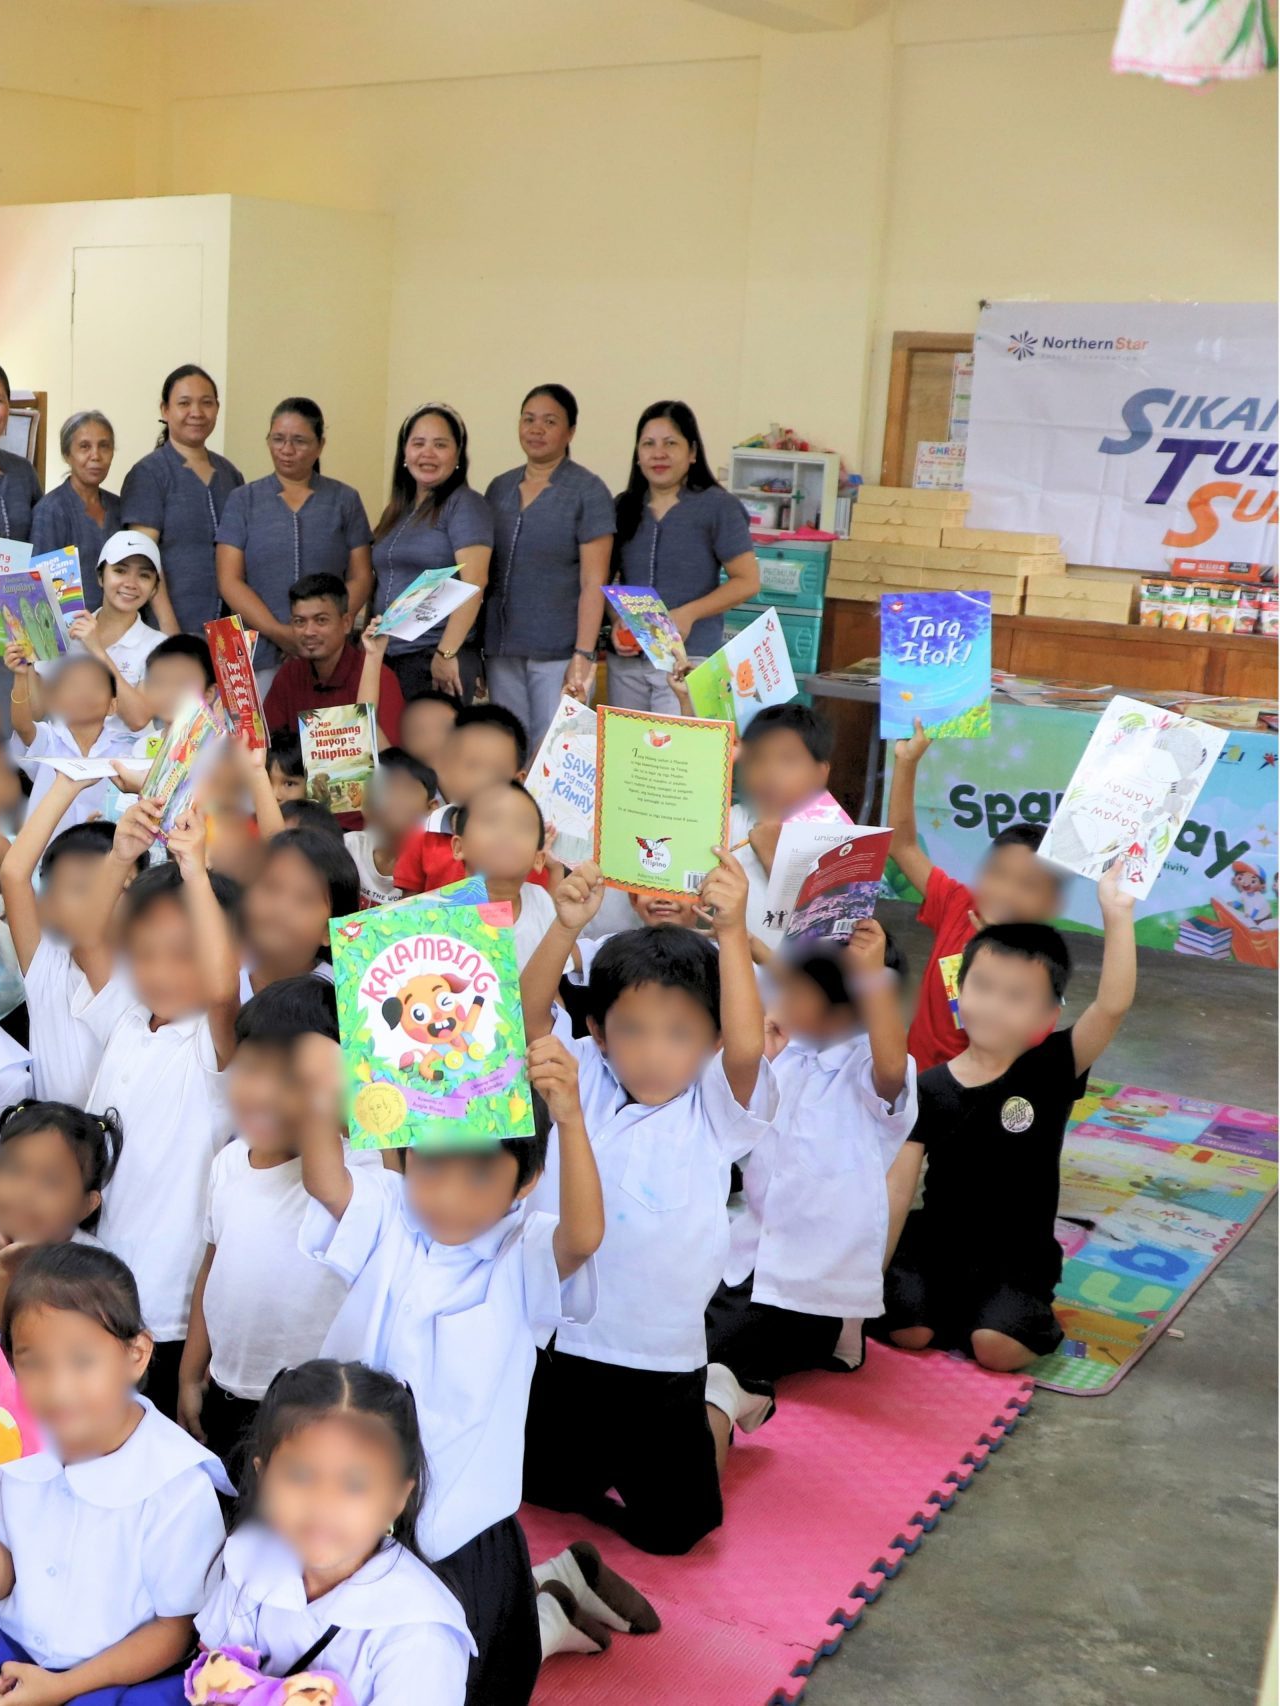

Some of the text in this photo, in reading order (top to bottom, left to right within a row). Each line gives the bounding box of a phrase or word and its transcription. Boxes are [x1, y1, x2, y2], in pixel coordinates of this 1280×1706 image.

[1162, 481, 1278, 548] SU
[906, 615, 966, 642] Tara,
[762, 636, 782, 686] Sampung
[898, 640, 973, 667] Itok!
[753, 644, 773, 693] Eroplano
[309, 725, 361, 739] Sinaunang
[315, 736, 347, 749] Hayop
[310, 746, 363, 761] Pilipinas
[562, 753, 597, 785] SAYA
[552, 777, 594, 815] KAMAY
[814, 833, 844, 841] unicef
[641, 858, 667, 869] Filipino
[360, 937, 497, 1003] KALAMBING
